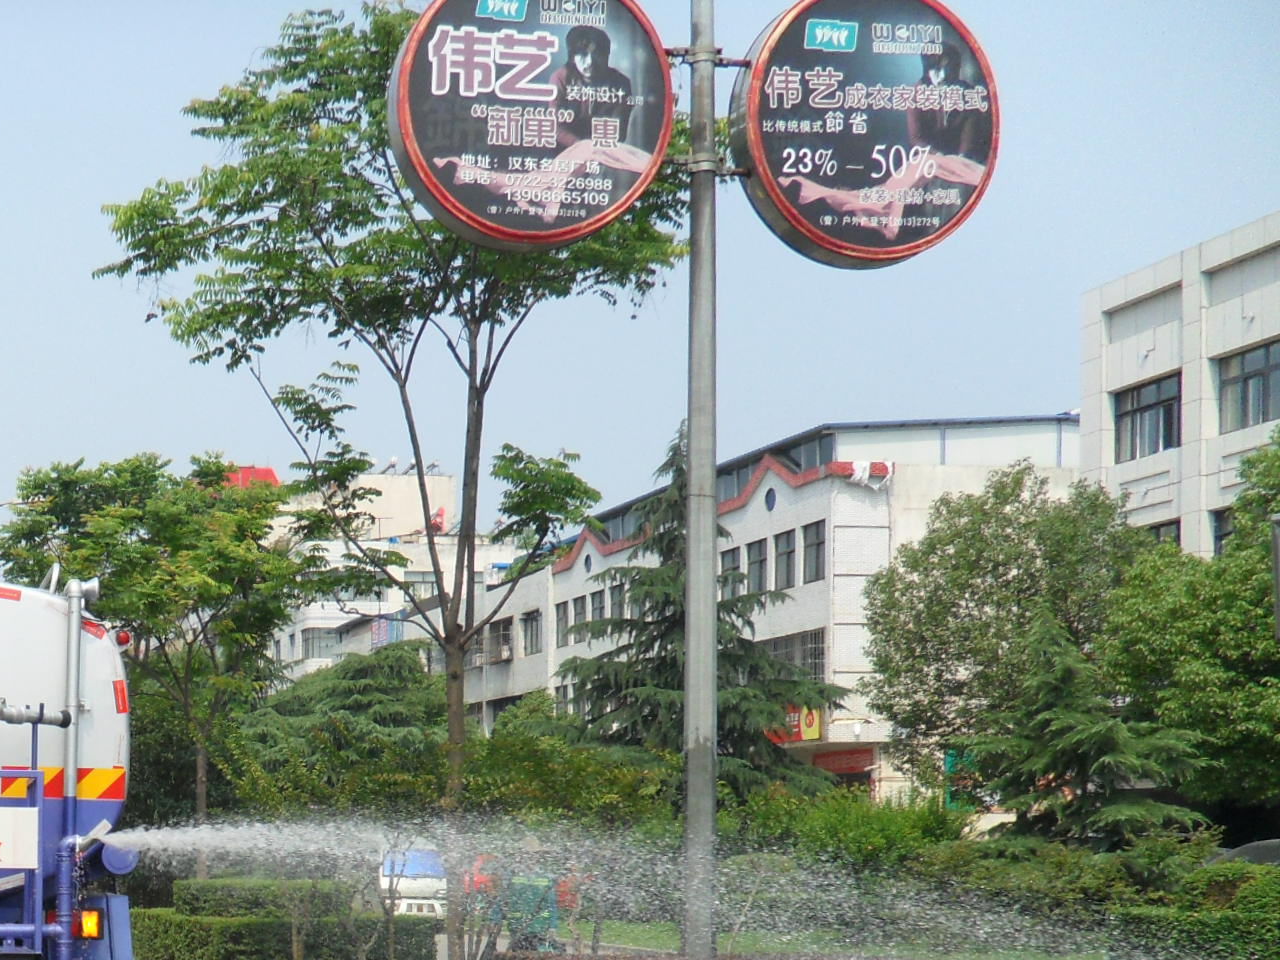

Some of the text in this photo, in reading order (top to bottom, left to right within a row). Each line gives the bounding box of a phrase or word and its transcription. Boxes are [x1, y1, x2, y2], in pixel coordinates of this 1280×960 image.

[428, 25, 559, 101] 伟艺
[782, 147, 837, 176] 23%
[870, 145, 936, 178] 50%
[505, 173, 613, 191] 0722-3226988
[505, 189, 609, 206] 13908665109
